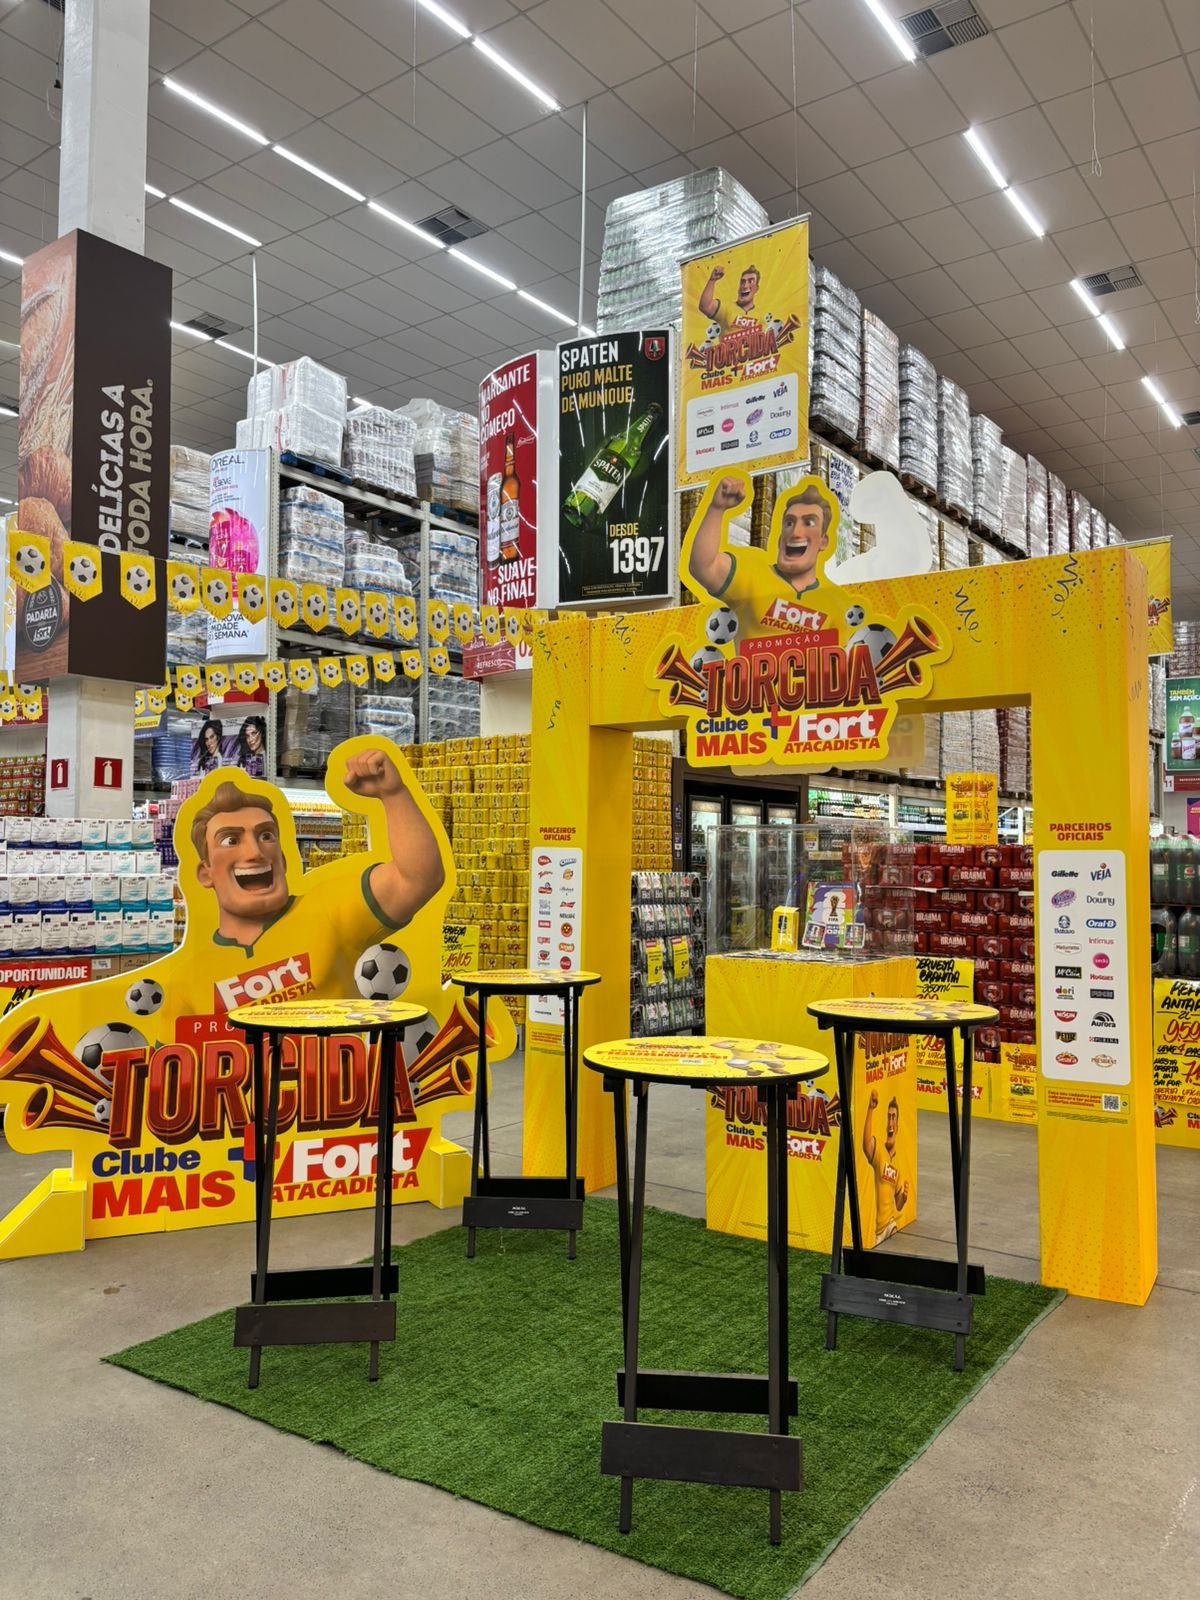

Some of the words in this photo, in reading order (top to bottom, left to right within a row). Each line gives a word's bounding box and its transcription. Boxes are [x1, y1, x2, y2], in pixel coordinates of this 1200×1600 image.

[561, 340, 619, 372] SPATEN
[705, 327, 778, 372] TORCIDA
[700, 369, 726, 380] Clube
[745, 356, 777, 376] Fort
[561, 371, 591, 392] PURO
[594, 364, 633, 385] MALTE
[700, 374, 733, 391] MAIS
[101, 385, 125, 409] A
[561, 396, 576, 414] DE
[578, 386, 636, 410] MUNIQUE.
[129, 378, 154, 473] HORA.
[480, 408, 515, 445] COMEÇO
[593, 459, 623, 482] SPATEN
[91, 410, 125, 555] DELÍCIAS
[127, 480, 152, 556] TODA
[609, 522, 639, 537] DESDE
[610, 536, 665, 575] 1397
[487, 586, 499, 606] NO
[501, 577, 534, 603] FINAL
[26, 607, 58, 624] PADARIA
[773, 597, 821, 631] Fort
[748, 634, 821, 649] PROMOÇÃO
[702, 644, 882, 717] TORCIDA
[1169, 688, 1195, 697] TAMBÉM
[695, 717, 749, 734] Clube
[799, 709, 876, 742] Fort
[695, 731, 767, 758] MAIS
[783, 738, 881, 754] ATACADISTA
[539, 827, 576, 835] PARCEIROS
[1050, 822, 1112, 832] PARCEIROS
[1057, 831, 1105, 841] OFICIAIS
[543, 834, 572, 842] OFICIAIS
[960, 871, 986, 881] BRAHMA
[1051, 869, 1079, 878] Gillette
[1090, 868, 1112, 881] VEJA
[1086, 895, 1115, 906] Downy
[916, 912, 941, 922] BRAHMA
[961, 914, 988, 925] BRAHMA
[1087, 920, 1115, 928] Oral-B
[940, 935, 967, 946] BRAHMA
[1088, 937, 1114, 945] Intimus
[215, 957, 310, 1012] Fort
[1055, 985, 1074, 995] dori
[1091, 1020, 1116, 1028] Aurora
[890, 1053, 906, 1072] Fort
[865, 1067, 884, 1085] MAIS
[101, 1033, 417, 1150] TORCIDA
[726, 1123, 754, 1136] Clube
[726, 1133, 765, 1151] MAIS
[92, 1146, 201, 1178] Clube
[292, 1130, 414, 1184] Fort
[91, 1170, 236, 1220] MAIS
